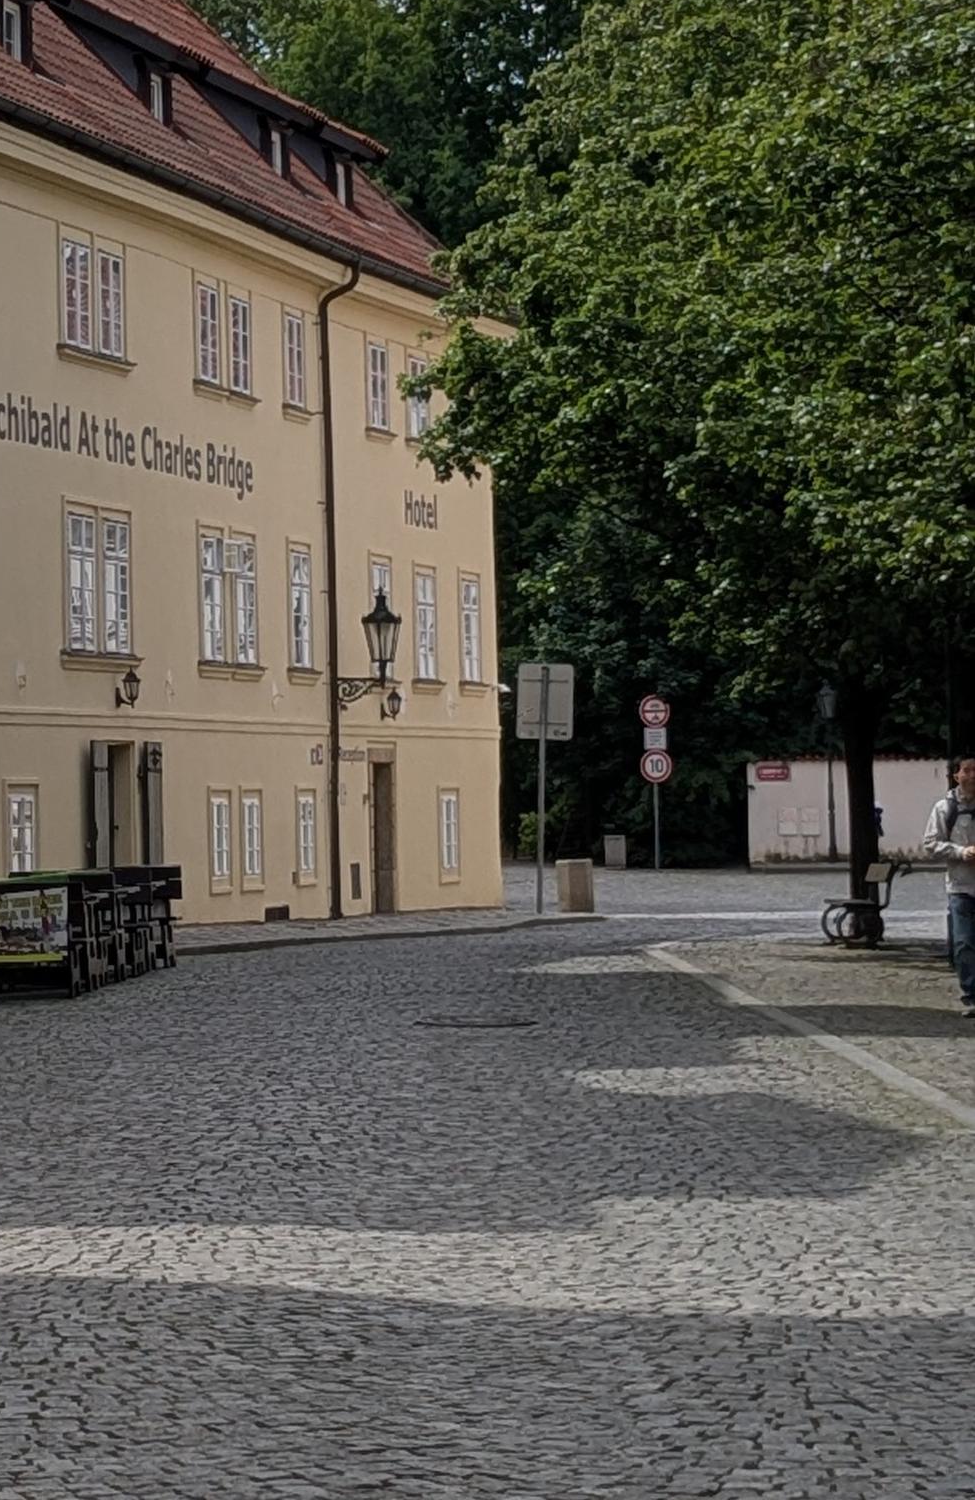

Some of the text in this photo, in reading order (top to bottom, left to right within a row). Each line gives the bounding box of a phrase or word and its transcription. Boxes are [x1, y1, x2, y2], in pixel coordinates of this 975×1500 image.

[77, 411, 99, 457] At
[104, 418, 136, 467] the
[141, 426, 202, 482] Charles
[206, 443, 254, 501] Bridge
[404, 489, 438, 530] Hotel
[649, 759, 664, 773] 10
